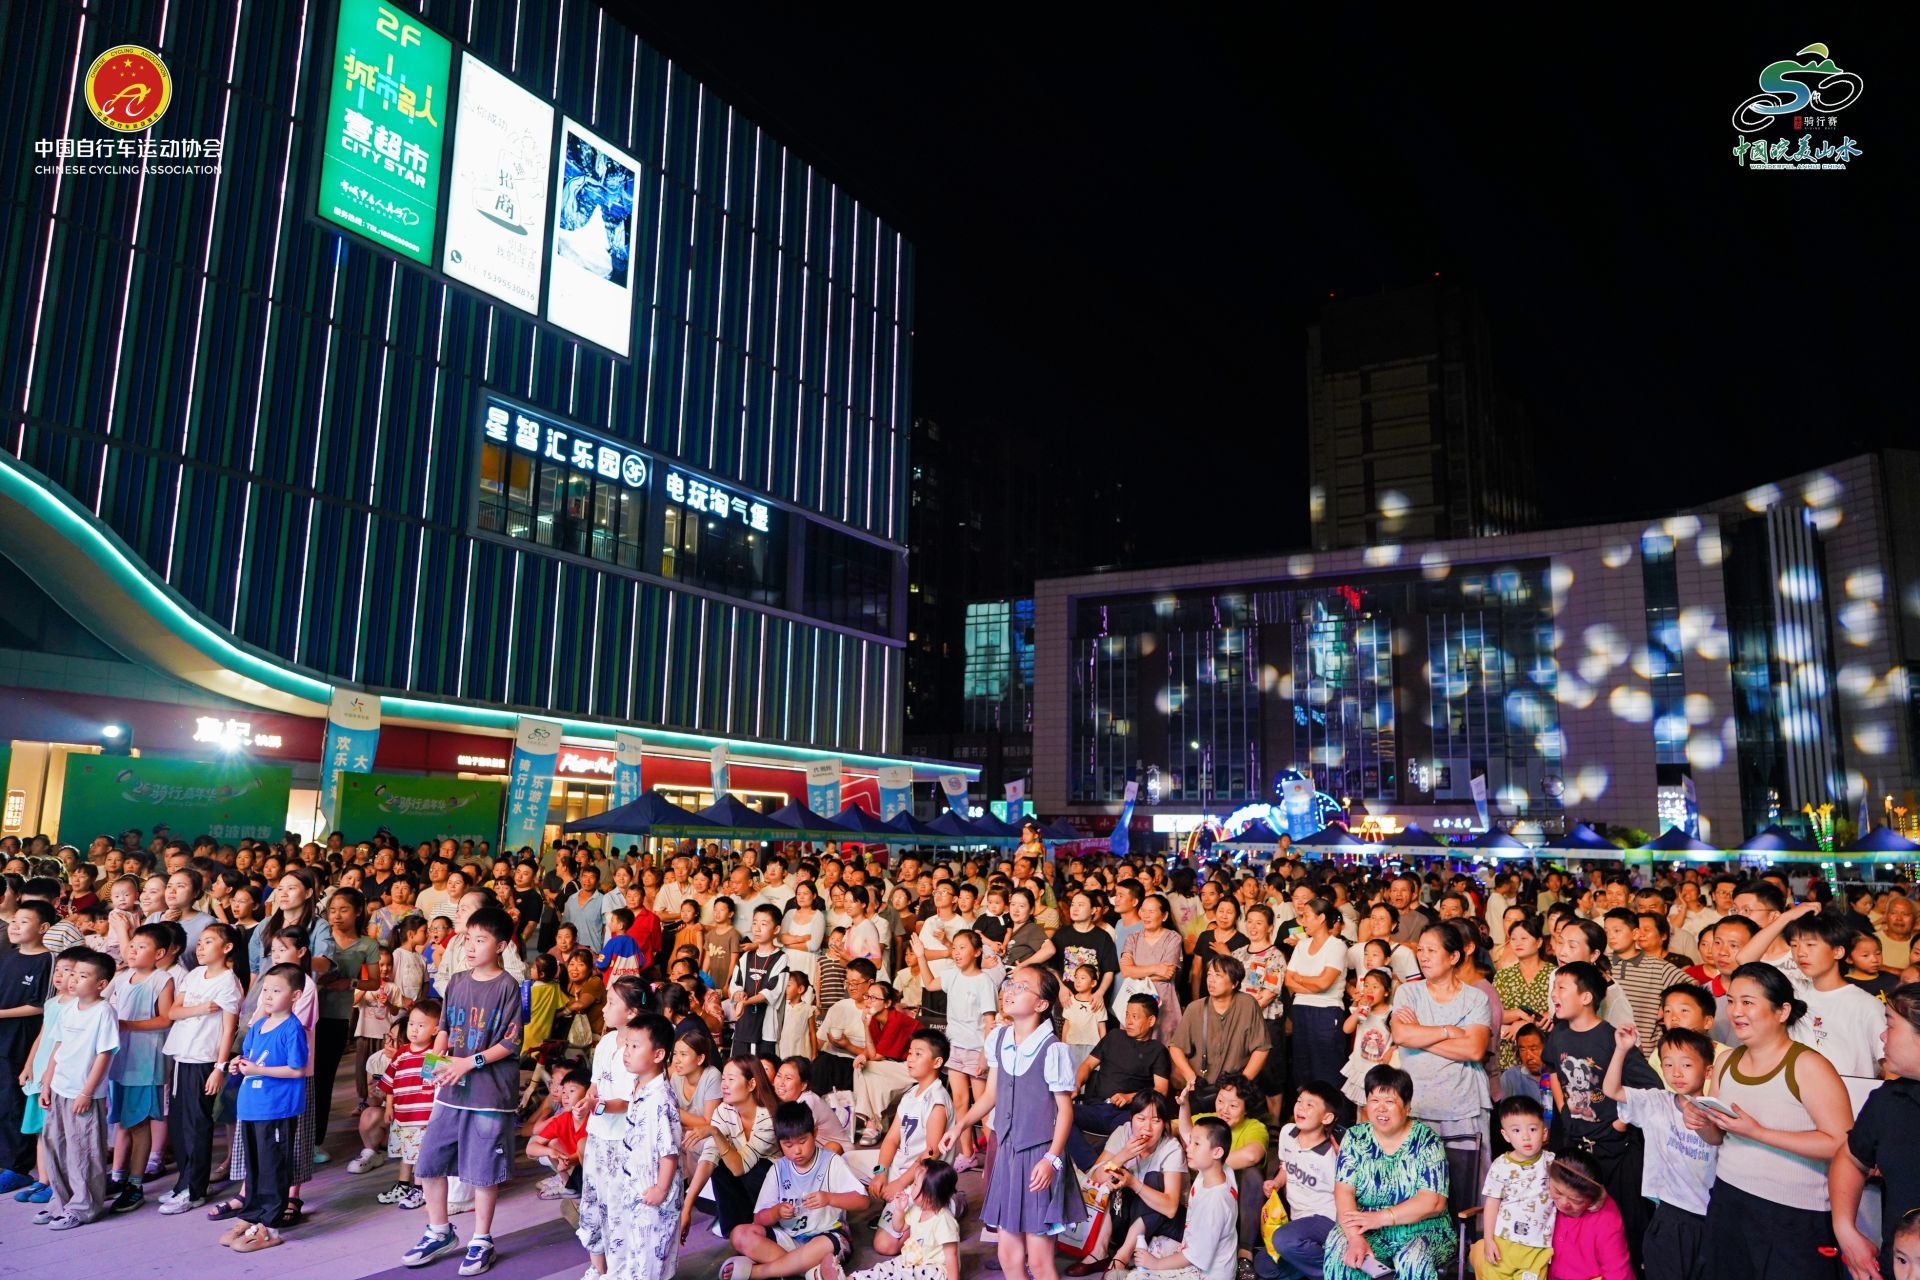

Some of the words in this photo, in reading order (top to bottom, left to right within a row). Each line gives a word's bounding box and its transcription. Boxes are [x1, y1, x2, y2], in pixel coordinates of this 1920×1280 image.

[376, 6, 421, 47] 2F
[341, 136, 381, 164] CITY
[384, 158, 426, 189] STAR
[342, 108, 429, 173] 壹超市
[494, 169, 514, 219] 招商
[485, 406, 621, 480] 星智汇乐园
[666, 472, 769, 533] 电玩淘气堡
[522, 775, 545, 831] 乐游弋江
